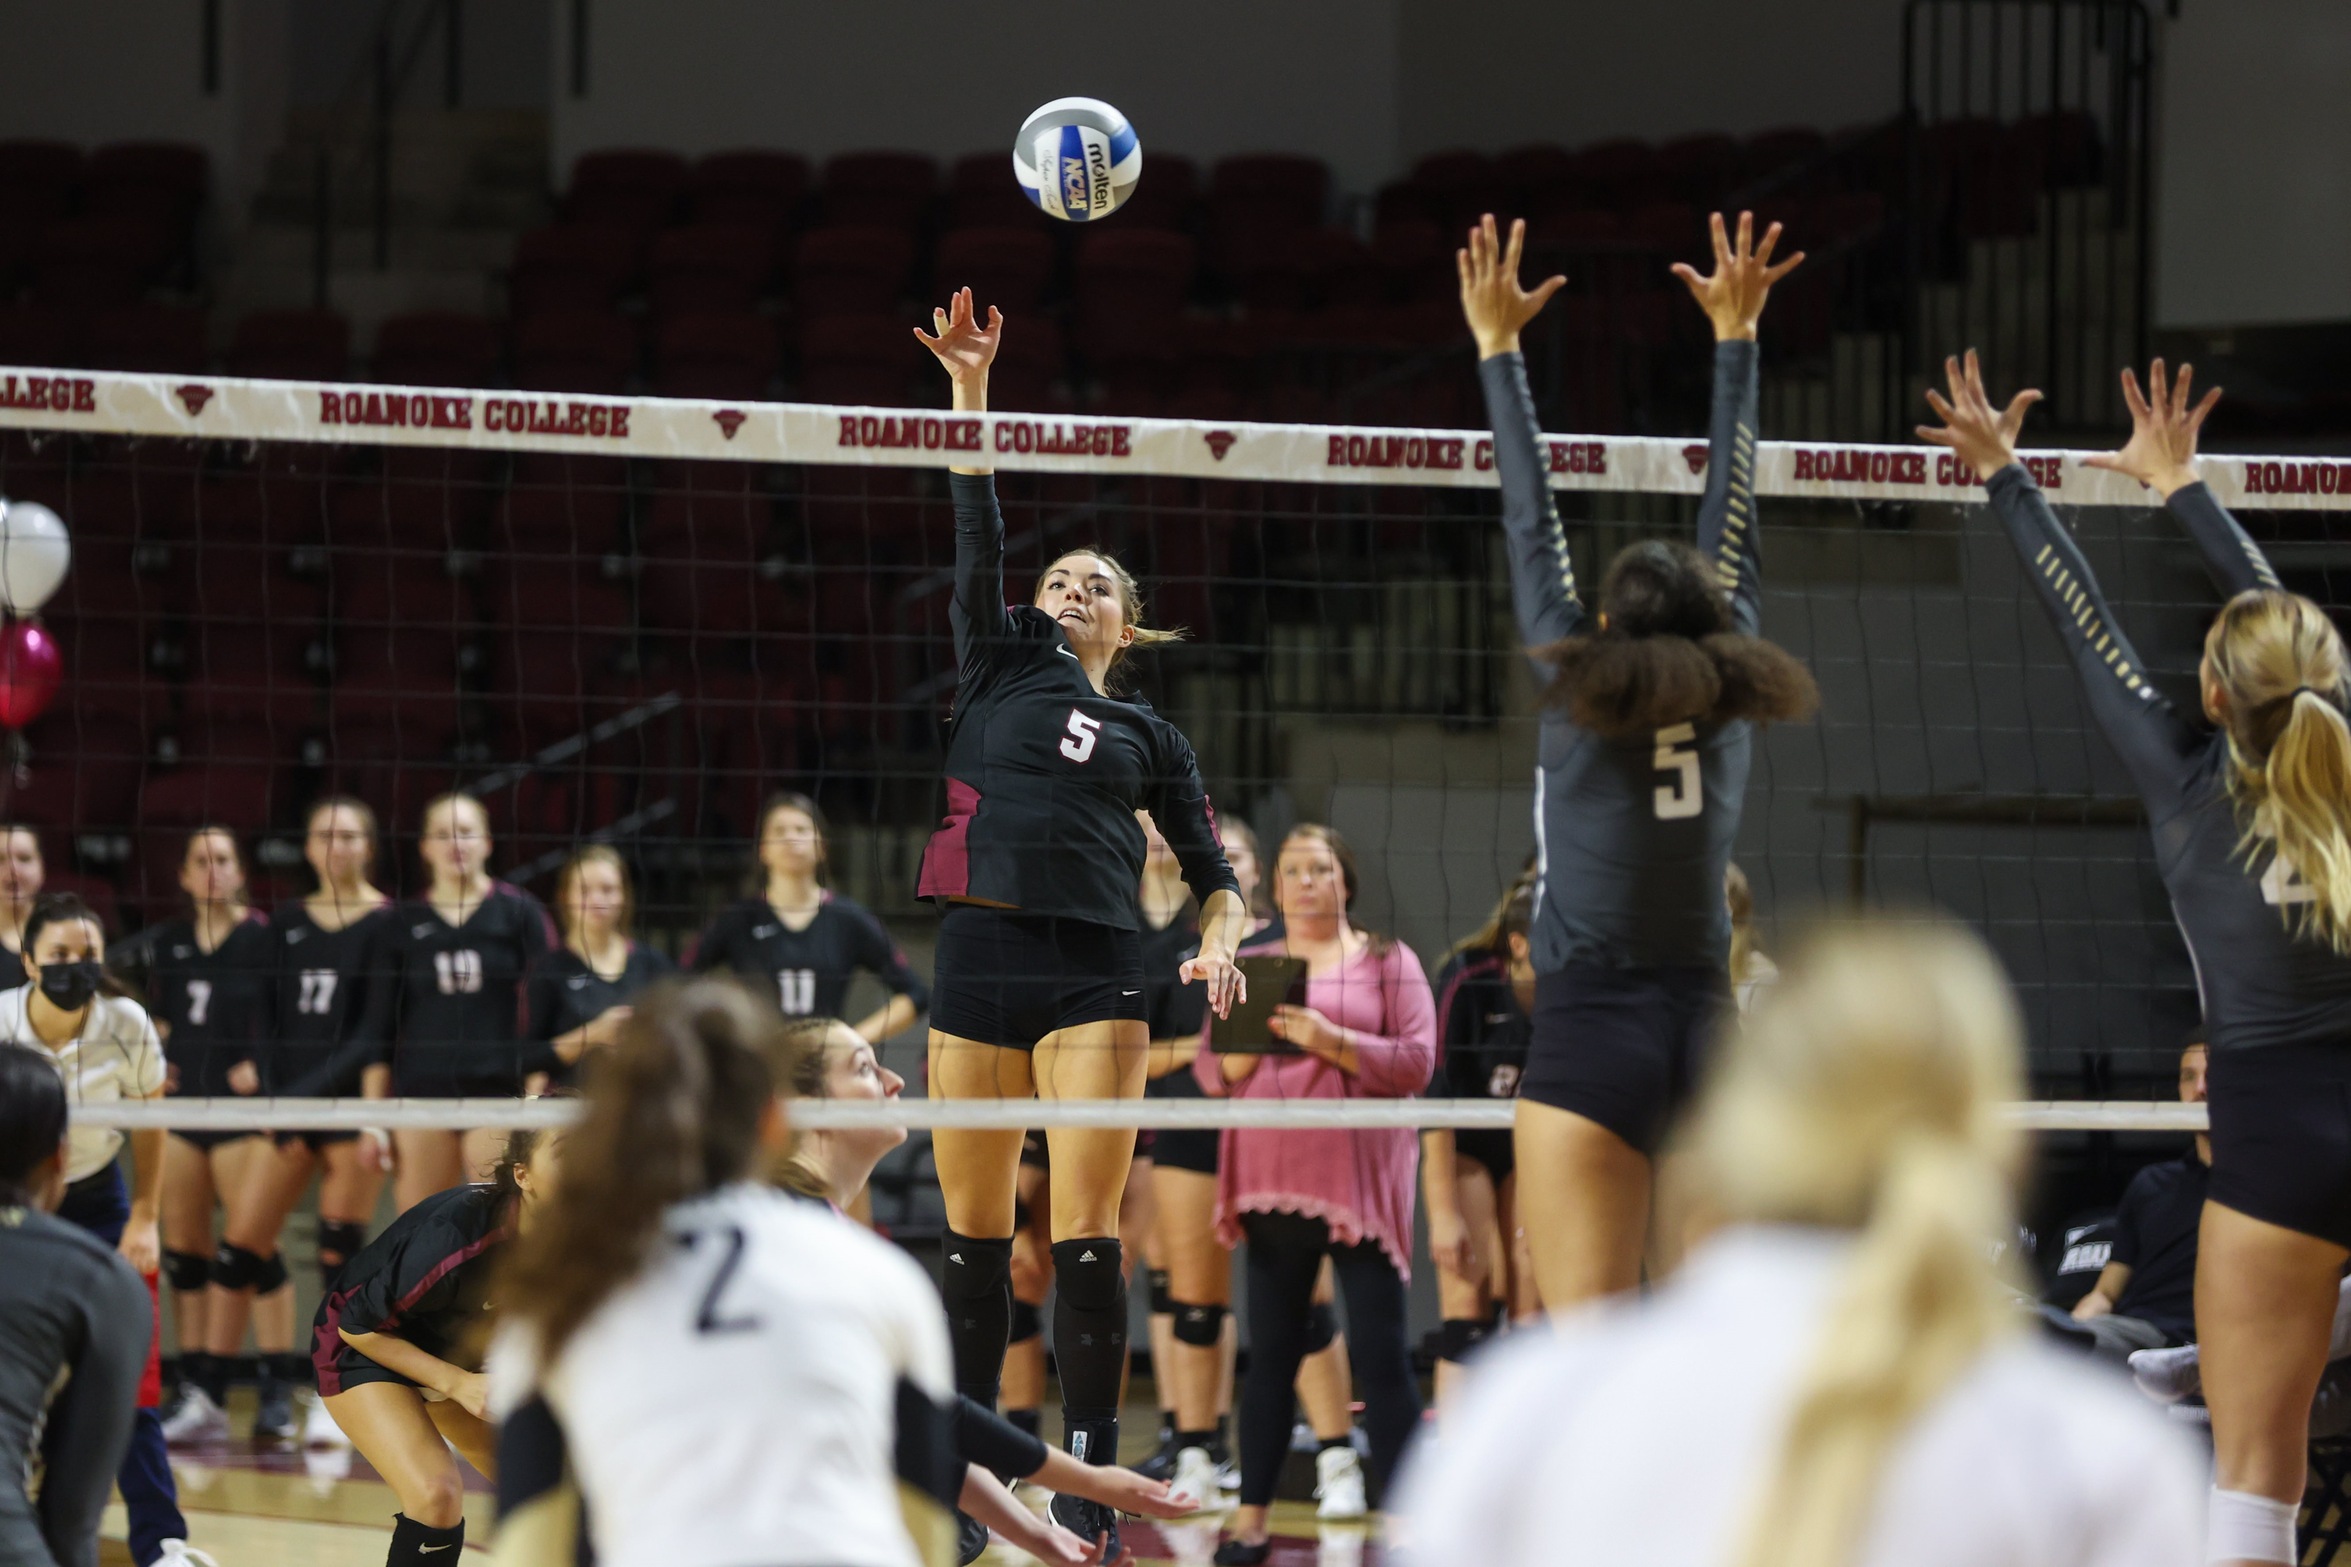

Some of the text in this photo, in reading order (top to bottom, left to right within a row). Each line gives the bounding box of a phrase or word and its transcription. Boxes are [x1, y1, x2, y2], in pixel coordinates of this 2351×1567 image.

[1061, 157, 1088, 209] NCAA
[1088, 143, 1110, 209] molten
[319, 391, 630, 437] ROANOKE COLLEGE
[839, 416, 1131, 456] ROANOKE COLLEGE
[1327, 435, 1465, 470] ROANOKE
[1794, 450, 1927, 484] ROANOKE
[1059, 707, 1101, 764] 5
[1653, 721, 1703, 819] 5
[187, 979, 212, 1025] 7
[299, 968, 337, 1014] 17
[778, 968, 815, 1015] 11
[677, 1223, 768, 1338] 2
